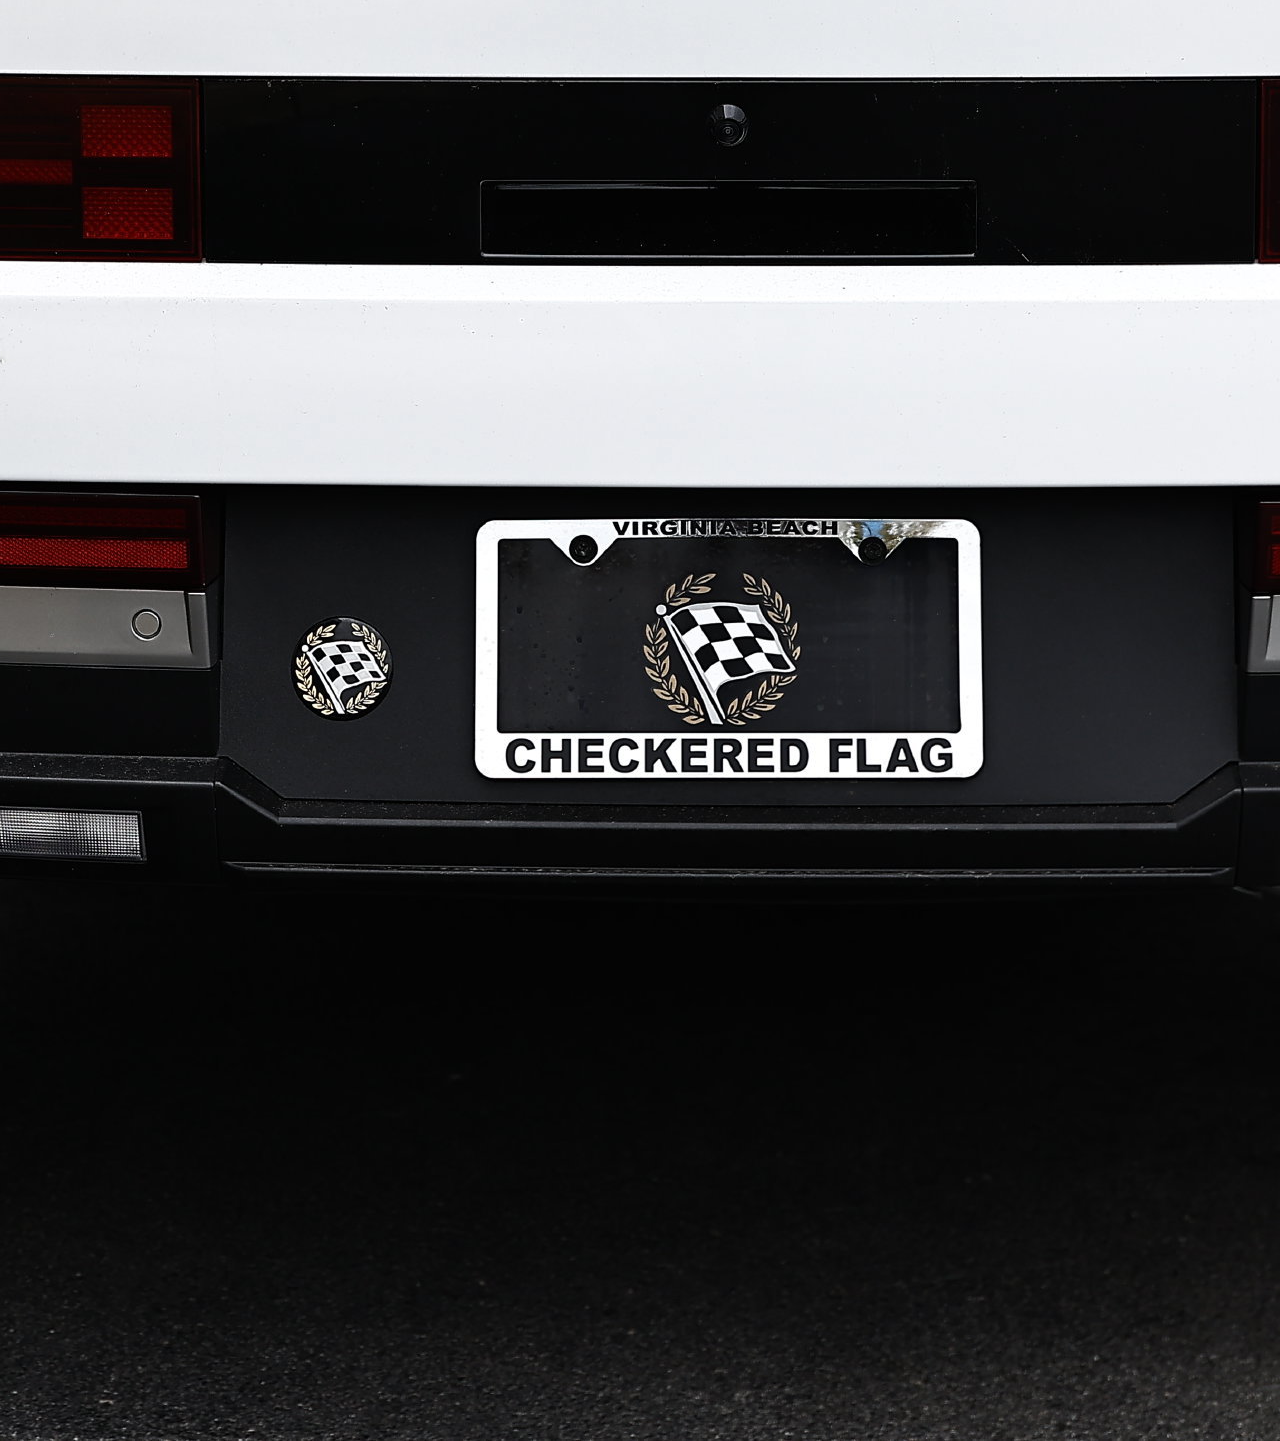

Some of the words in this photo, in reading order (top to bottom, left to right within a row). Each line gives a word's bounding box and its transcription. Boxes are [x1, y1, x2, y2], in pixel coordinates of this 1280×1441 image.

[612, 521, 737, 536] VIRGINIA
[747, 520, 838, 536] BEACH
[505, 738, 810, 773] CHECKERED
[829, 738, 954, 773] FLAG
